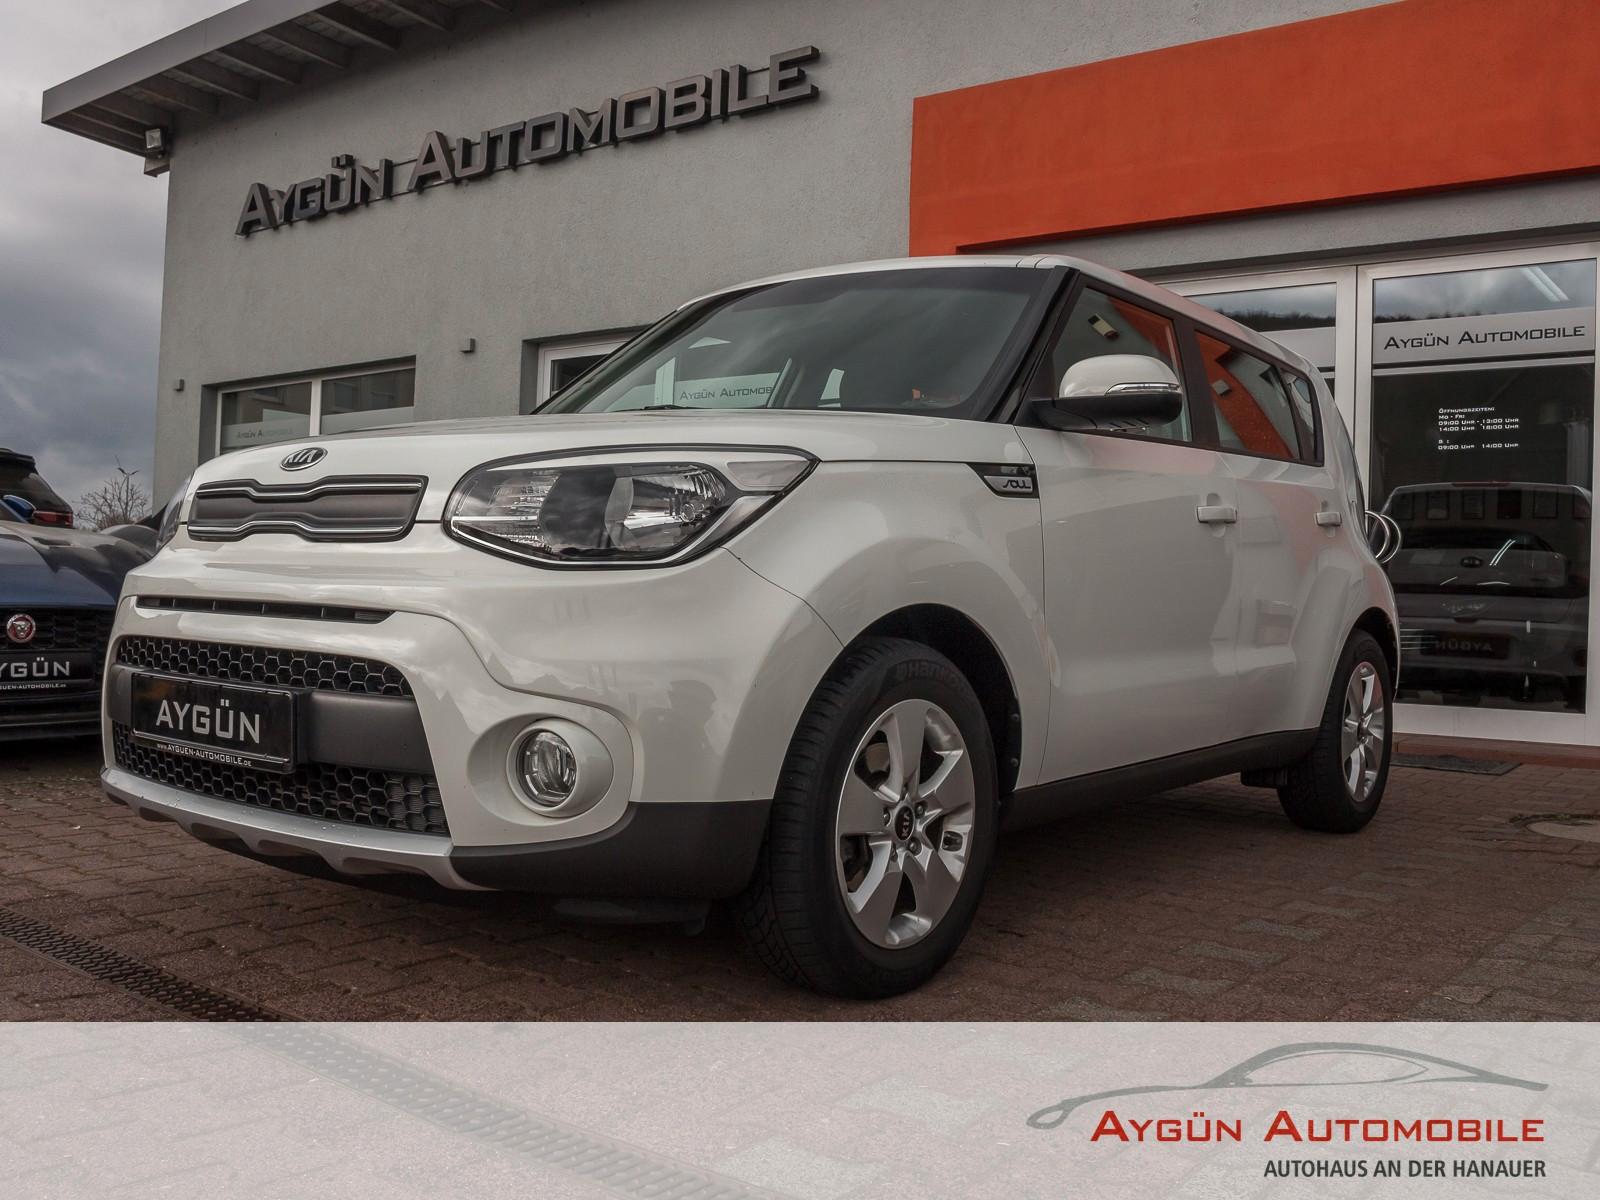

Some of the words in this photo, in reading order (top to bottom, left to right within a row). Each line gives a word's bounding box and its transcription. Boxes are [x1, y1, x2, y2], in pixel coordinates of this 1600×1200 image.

[407, 45, 820, 192] AUTOMOBILE
[1458, 326, 1585, 345] AUTOMOBILE
[720, 386, 773, 397] AUTOMOB
[155, 698, 261, 745] AYGÜN
